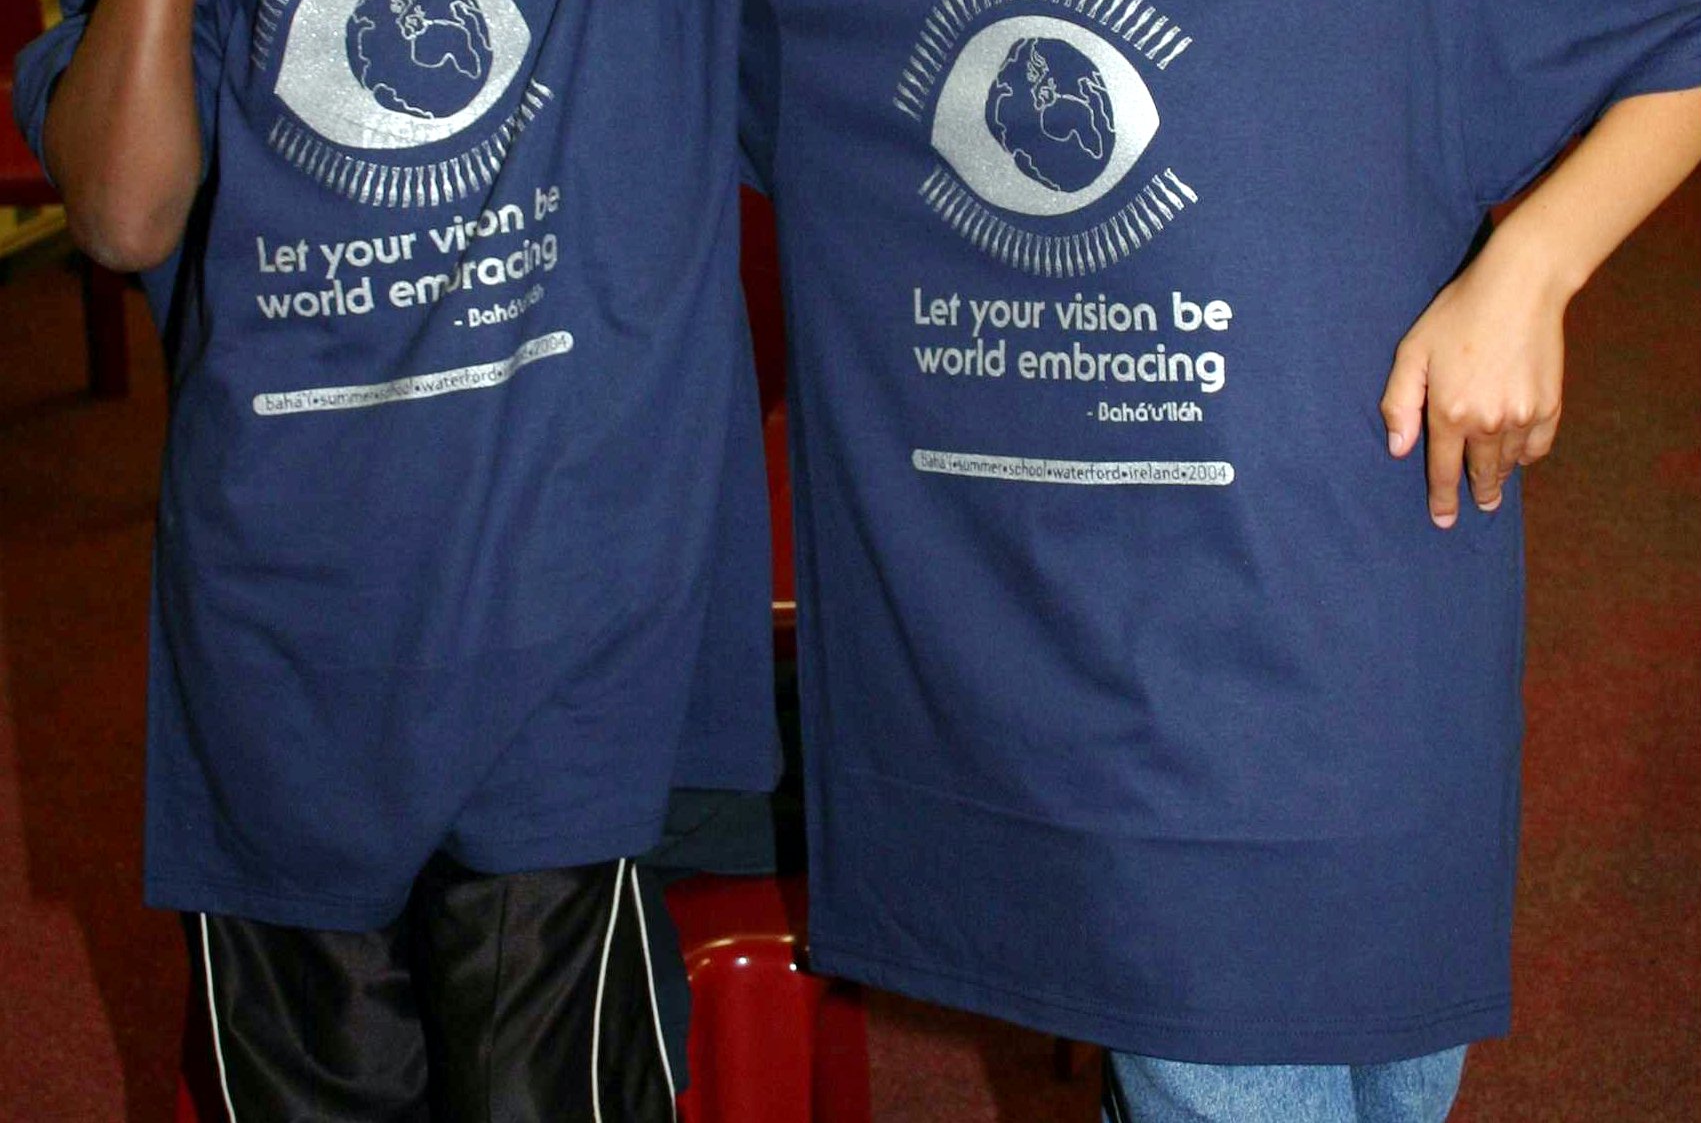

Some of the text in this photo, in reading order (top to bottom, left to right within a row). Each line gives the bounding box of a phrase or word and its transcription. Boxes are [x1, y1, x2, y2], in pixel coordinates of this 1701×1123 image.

[256, 236, 309, 274] Let
[320, 232, 417, 280] your
[534, 185, 560, 221] be
[256, 277, 374, 319] world
[913, 287, 1233, 337] Let your vision be
[913, 339, 1226, 393] world embracing
[1189, 465, 1227, 480] 2004
